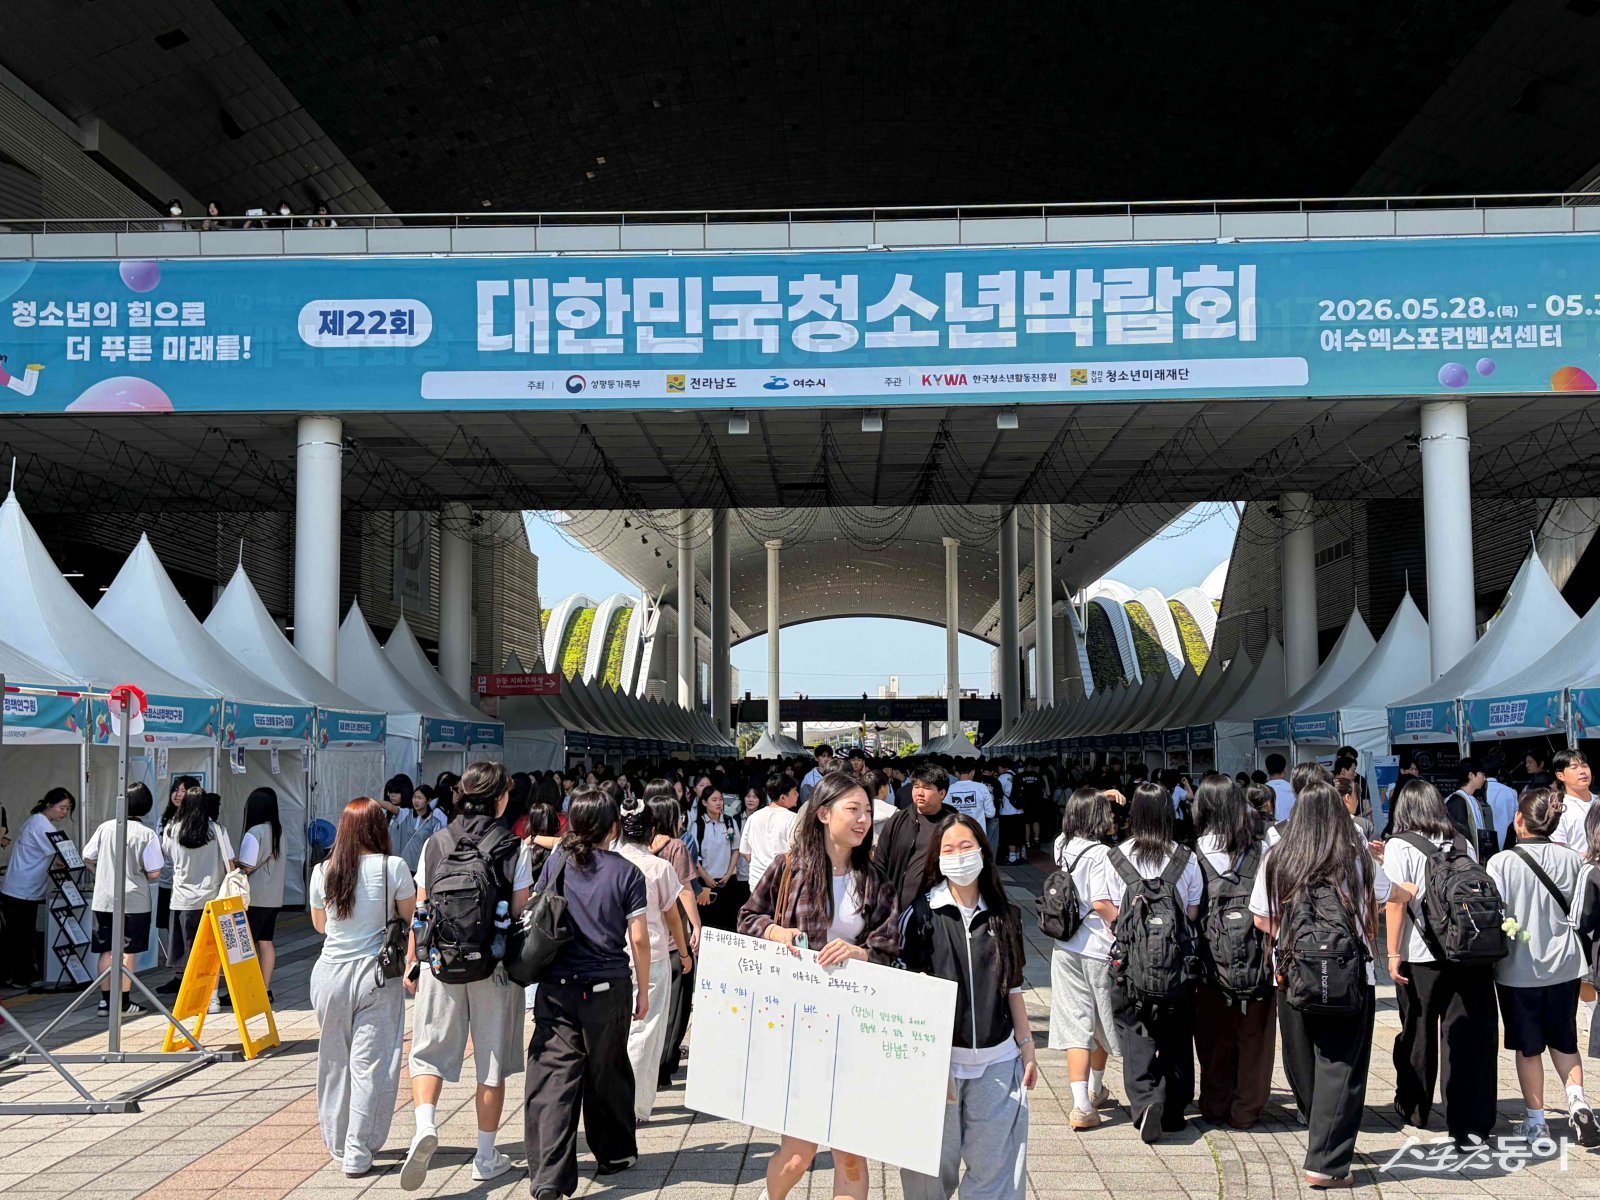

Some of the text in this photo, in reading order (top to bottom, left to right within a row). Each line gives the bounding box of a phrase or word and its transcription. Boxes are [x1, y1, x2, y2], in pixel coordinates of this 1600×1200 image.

[11, 301, 206, 329] 청소년의 힘으로
[476, 264, 1257, 354] 대한민국청소년박람회
[1318, 296, 1519, 322] 2026.05.28.(목)
[318, 308, 416, 337] 제22회
[1320, 324, 1563, 352] 여수엑스포컨벤션센터
[66, 334, 252, 362] 더 푸른 미래를!
[884, 376, 902, 387] 주관
[921, 373, 968, 387] KYWA
[972, 372, 1057, 384] 한국청소년활동진흥원
[1105, 367, 1190, 383] 청소년미래재단
[527, 380, 545, 390] 주최
[590, 379, 641, 389] 성평등가족부
[690, 377, 737, 389] 전라남도
[793, 377, 826, 389] 여수시
[3, 698, 37, 712] 정책연구원
